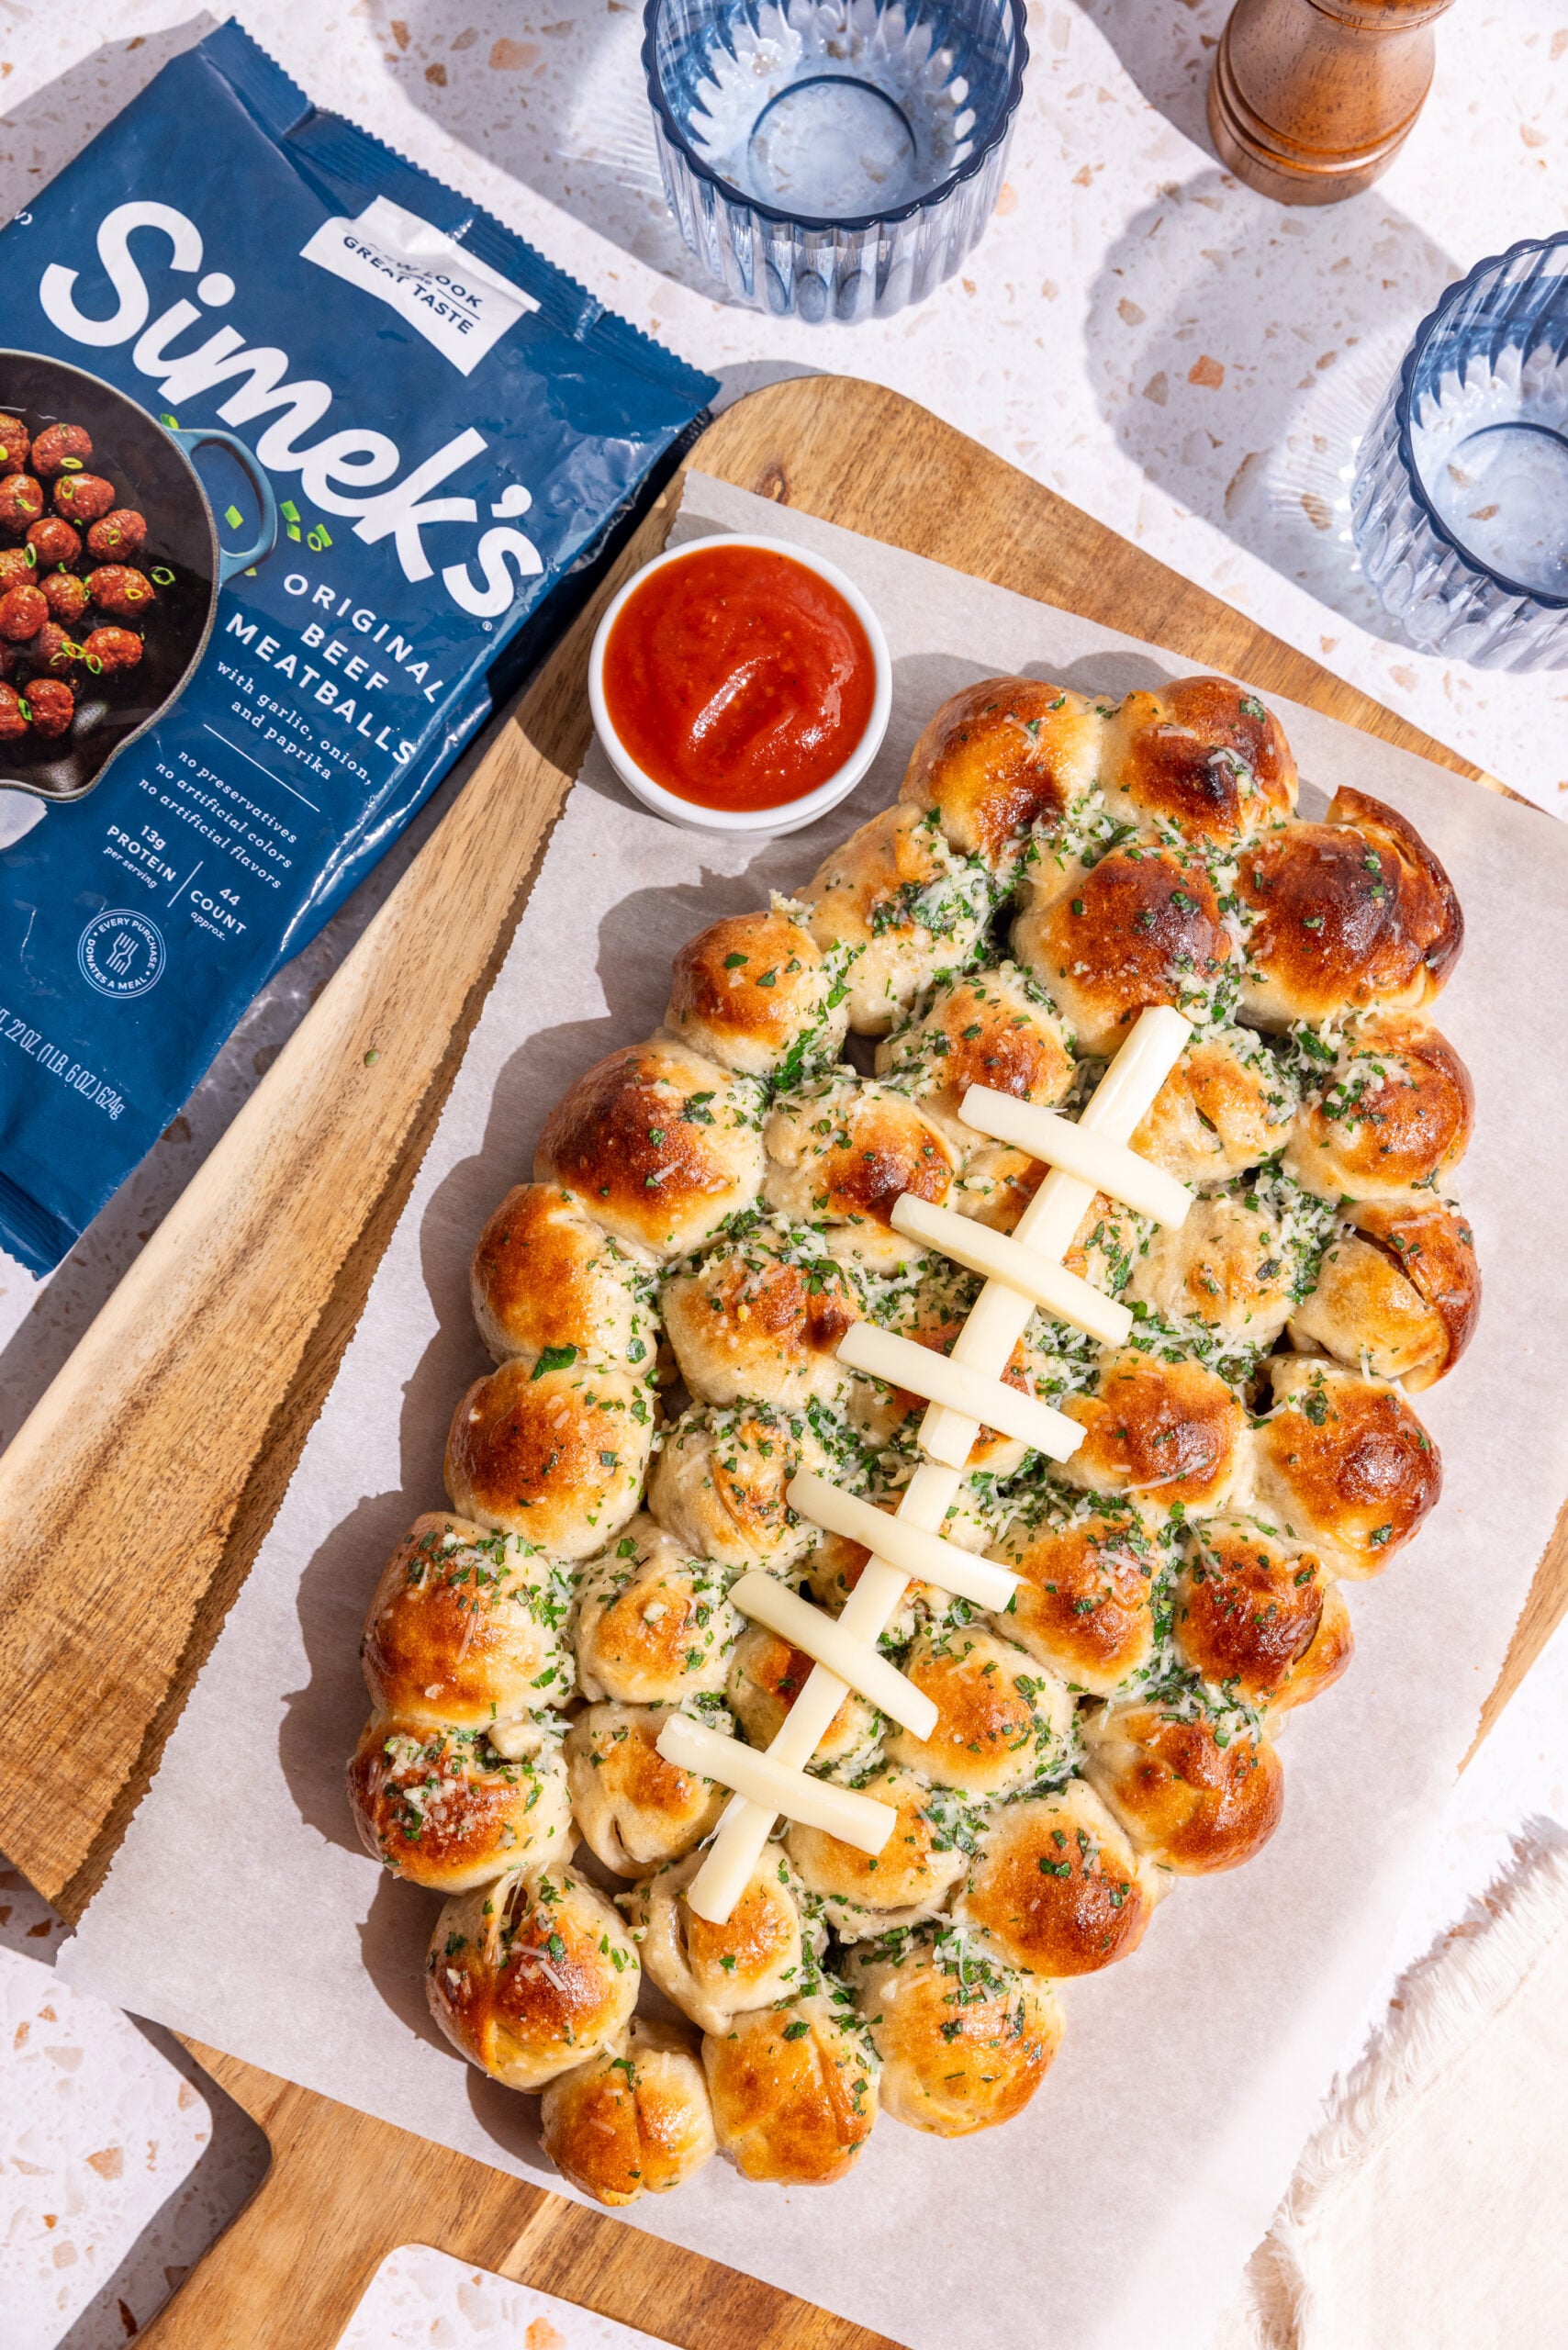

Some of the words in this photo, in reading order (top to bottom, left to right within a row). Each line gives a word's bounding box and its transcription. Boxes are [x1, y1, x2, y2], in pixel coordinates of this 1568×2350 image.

[413, 283, 474, 334] TASTE
[39, 200, 543, 619] Simek's
[284, 573, 443, 703] ORIGINAL
[300, 622, 389, 690] BEEF
[225, 612, 417, 765] MEATBALLS
[217, 661, 255, 695] with
[256, 693, 314, 742] garlic,
[319, 739, 372, 786] onion,
[231, 699, 265, 728] and
[263, 725, 331, 780] paprika
[155, 763, 174, 779] no
[177, 779, 249, 834] artificial
[246, 833, 293, 869] colors
[178, 751, 196, 768] no
[196, 767, 297, 844] preservatives
[103, 845, 124, 863] per
[122, 859, 158, 889] serving
[106, 824, 177, 882] PROTEIN
[139, 778, 157, 796] no
[160, 794, 230, 849] artificial
[229, 845, 281, 889] flavors
[140, 825, 166, 851] 13g
[190, 890, 247, 935] COUNT
[190, 912, 226, 941] approx.
[219, 888, 241, 906] 44
[85, 938, 108, 984] DONATES
[118, 976, 147, 990] MEAL
[98, 917, 130, 933] EVERY
[131, 920, 158, 969] PURCHASE
[4, 1018, 27, 1042] 22
[19, 1029, 42, 1056] OZ.
[46, 1049, 69, 1077] LB.
[64, 1063, 81, 1082] 6
[95, 1086, 126, 1120] 624g
